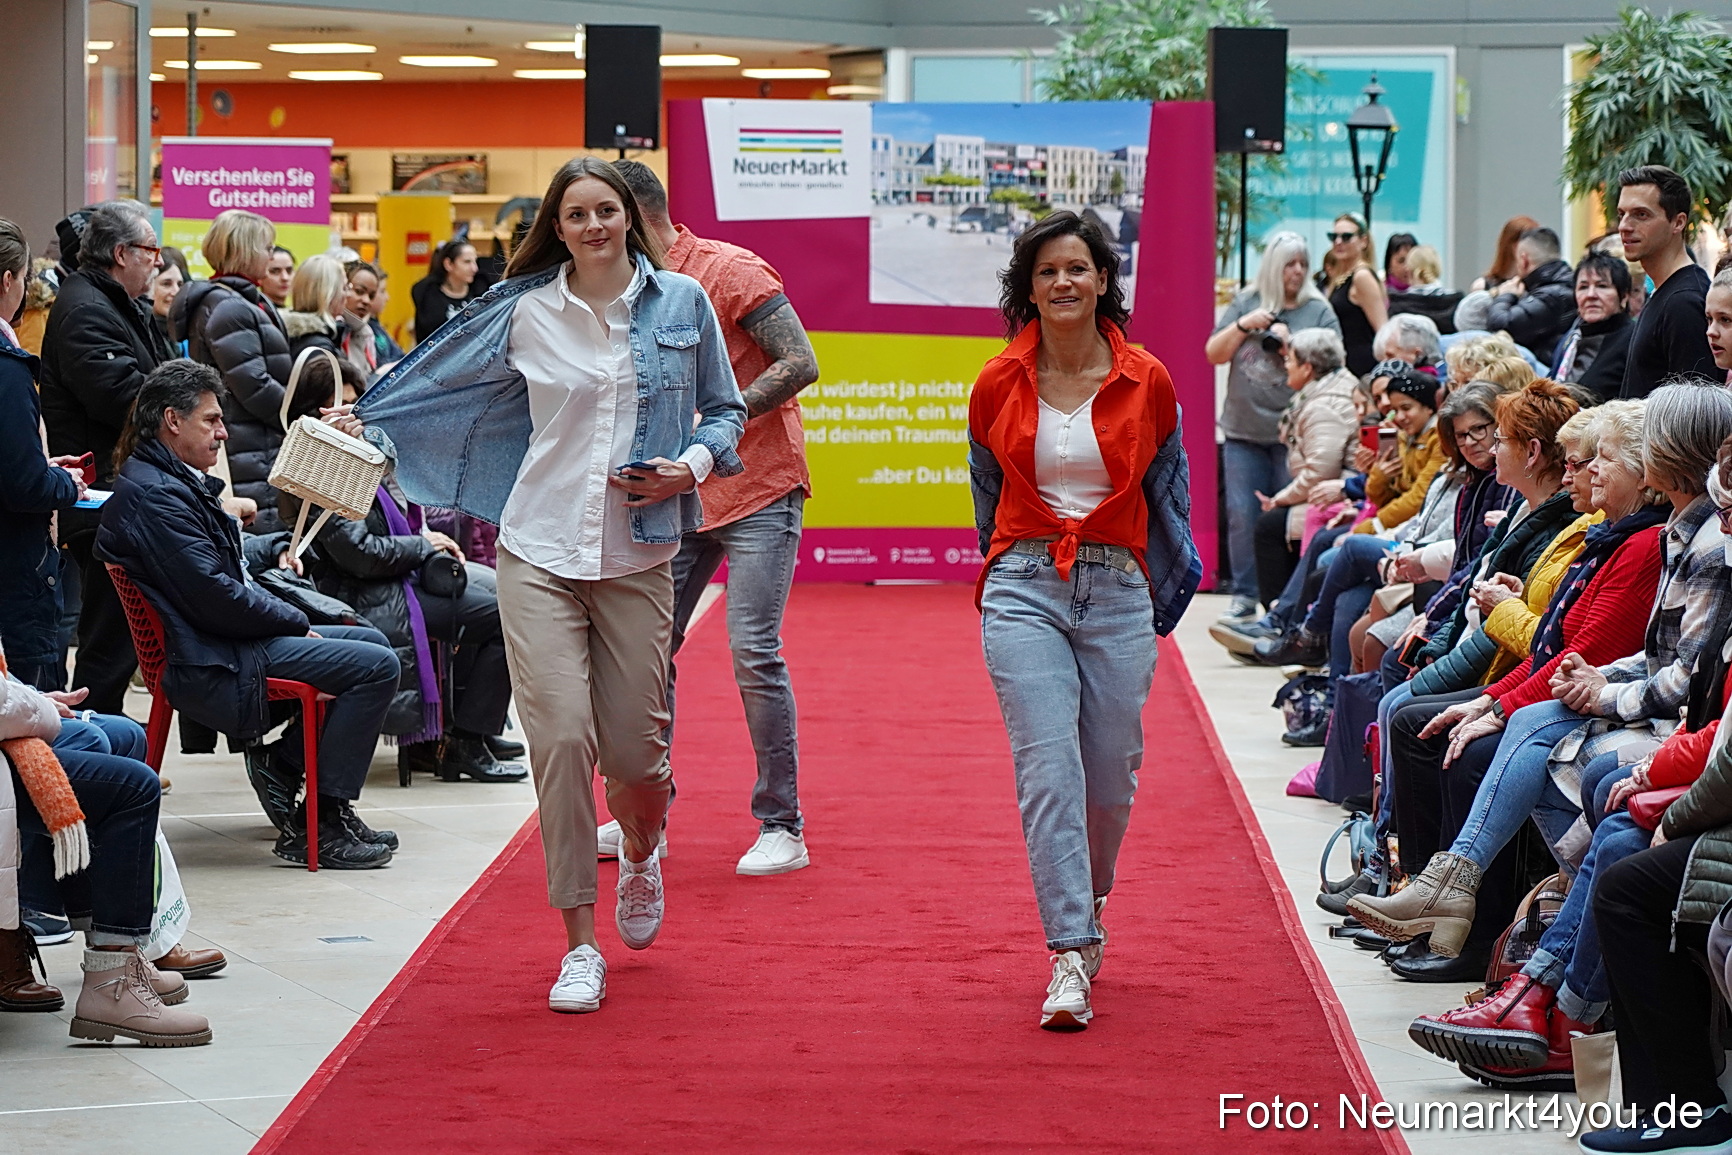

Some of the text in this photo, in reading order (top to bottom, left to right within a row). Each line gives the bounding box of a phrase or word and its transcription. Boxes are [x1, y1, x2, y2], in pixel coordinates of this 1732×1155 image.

[733, 157, 849, 176] NeuerMarkt
[172, 166, 315, 187] Verschenken Sie
[209, 188, 315, 208] Gutscheine!
[822, 380, 897, 398] würdest
[899, 380, 915, 402] ja
[918, 380, 964, 398] nicht
[845, 403, 913, 422] kaufen,
[917, 403, 945, 420] ein
[828, 426, 891, 443] deinen
[916, 467, 941, 484] Du
